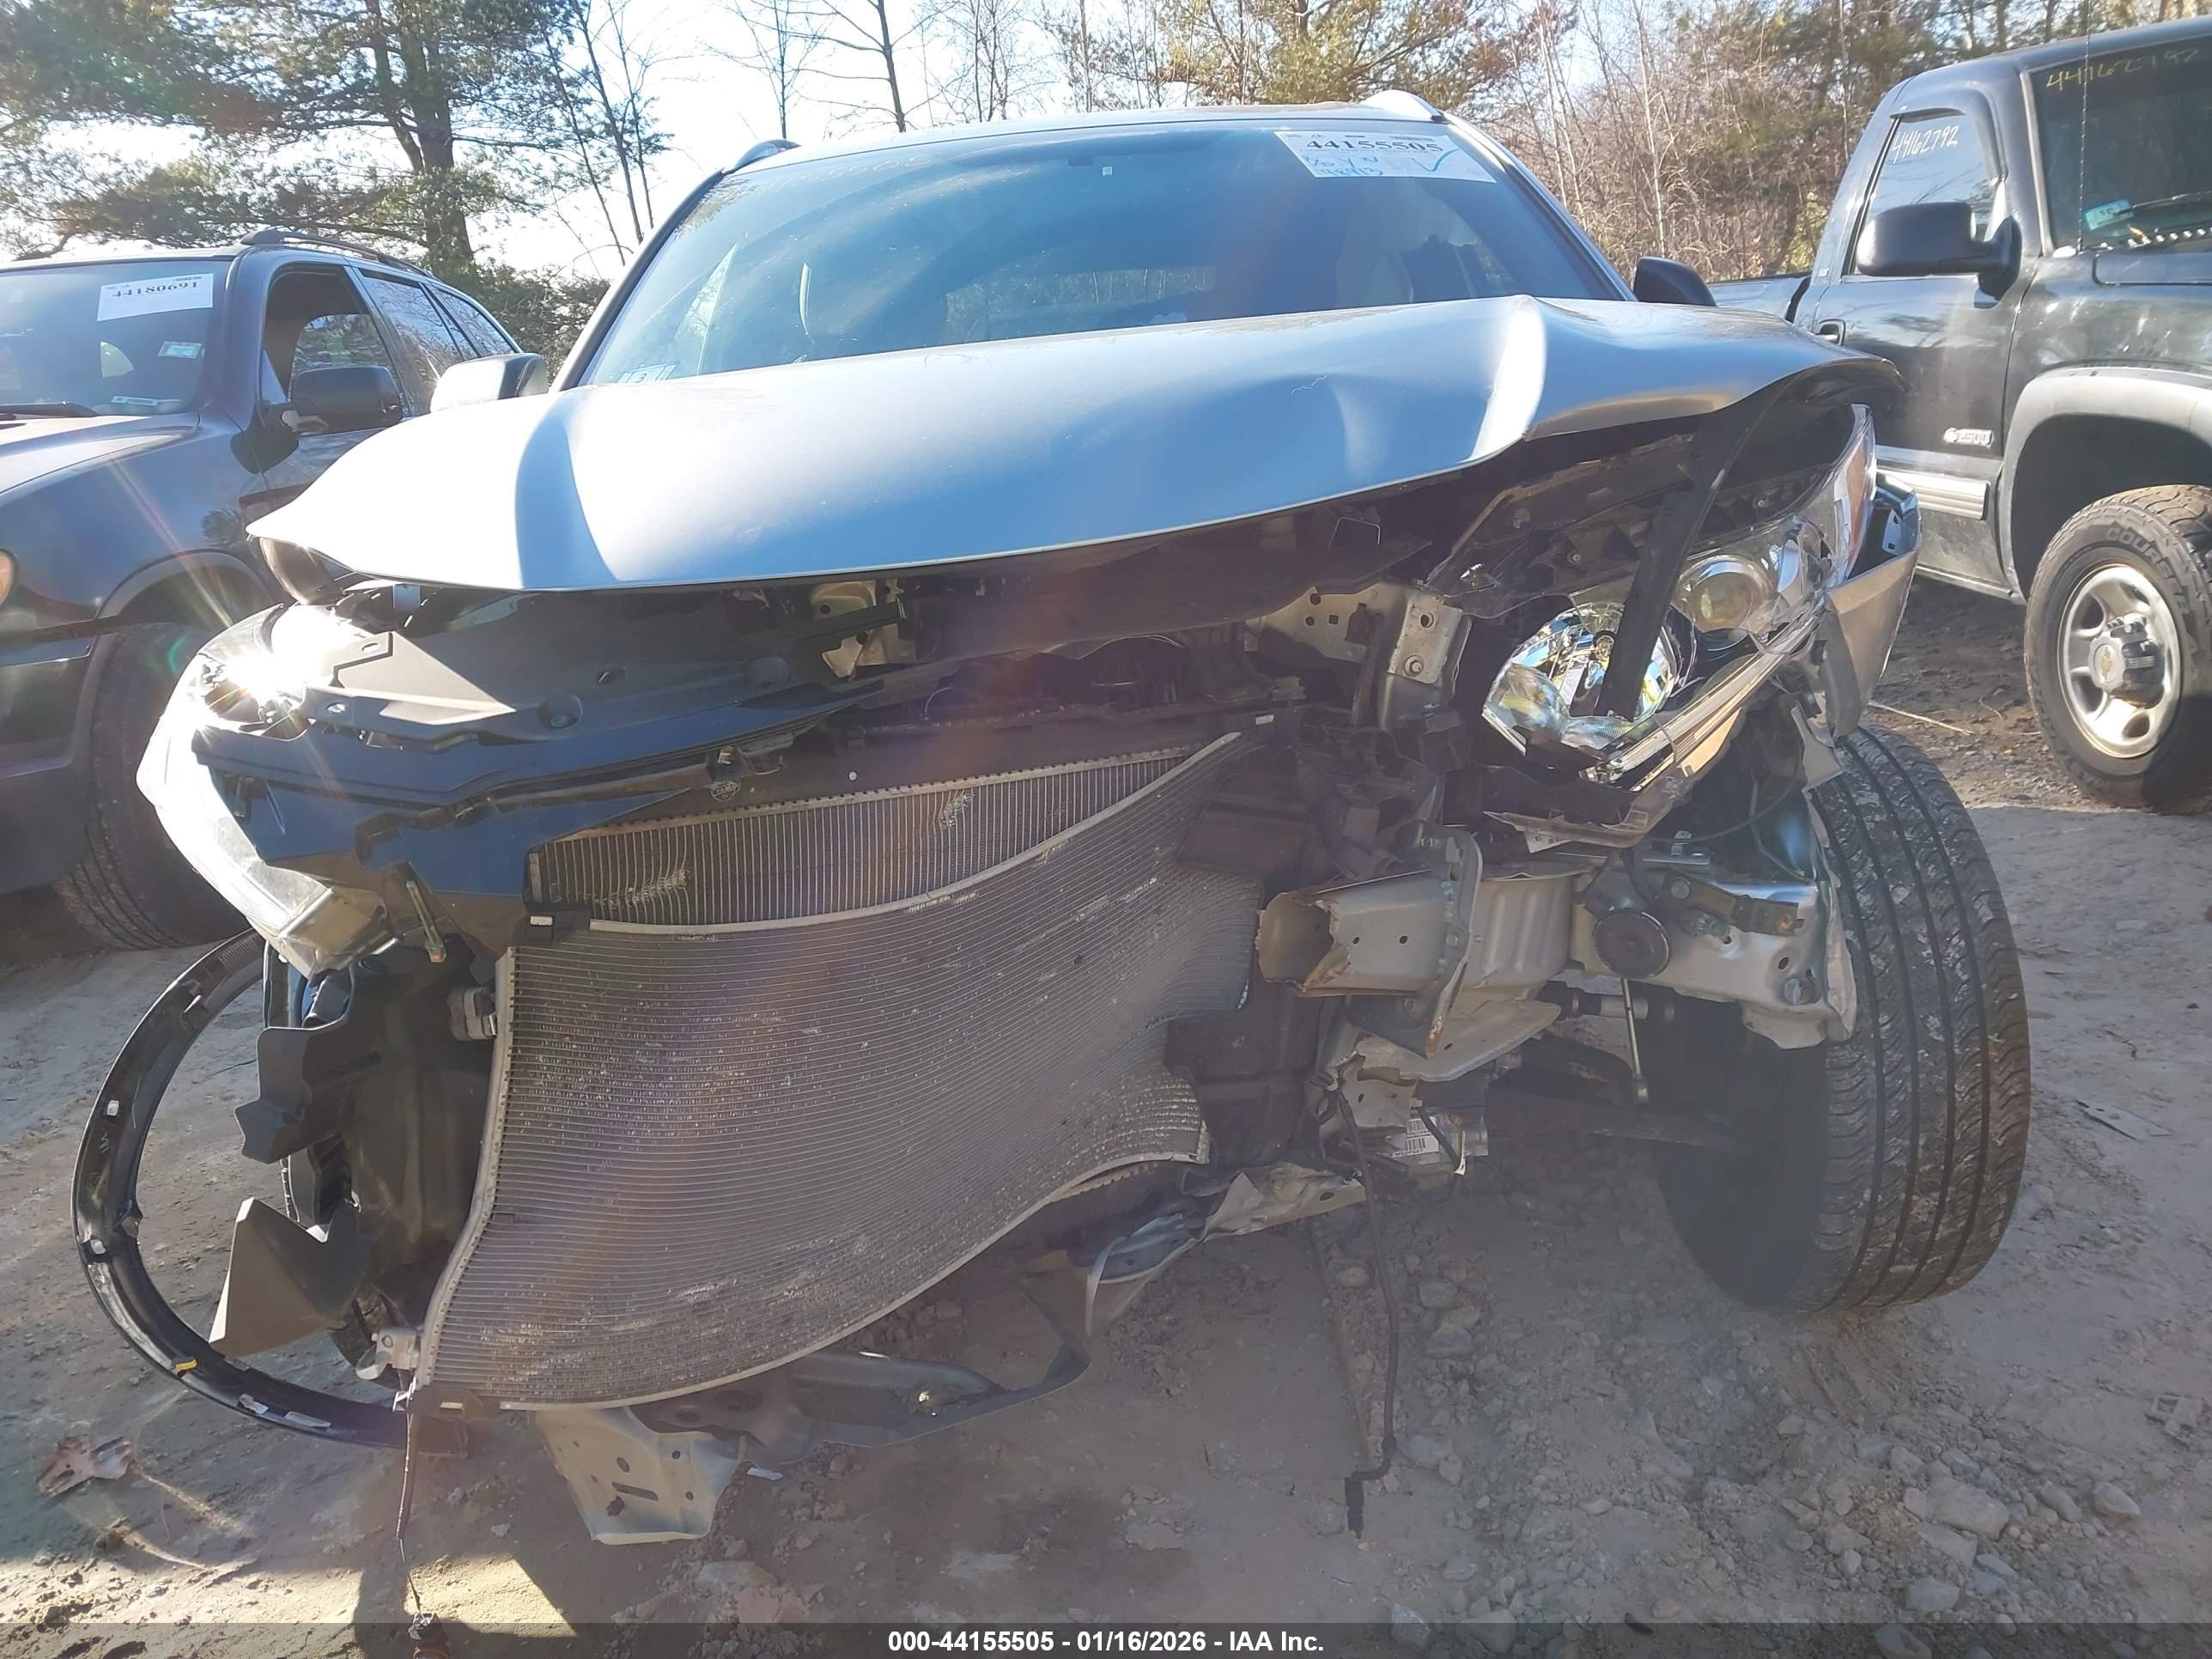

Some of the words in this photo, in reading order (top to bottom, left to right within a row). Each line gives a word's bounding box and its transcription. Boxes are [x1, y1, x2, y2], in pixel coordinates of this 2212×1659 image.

[1306, 140, 1443, 152] 44155505
[1893, 125, 1959, 165] 44162792
[112, 281, 198, 297] 44180691
